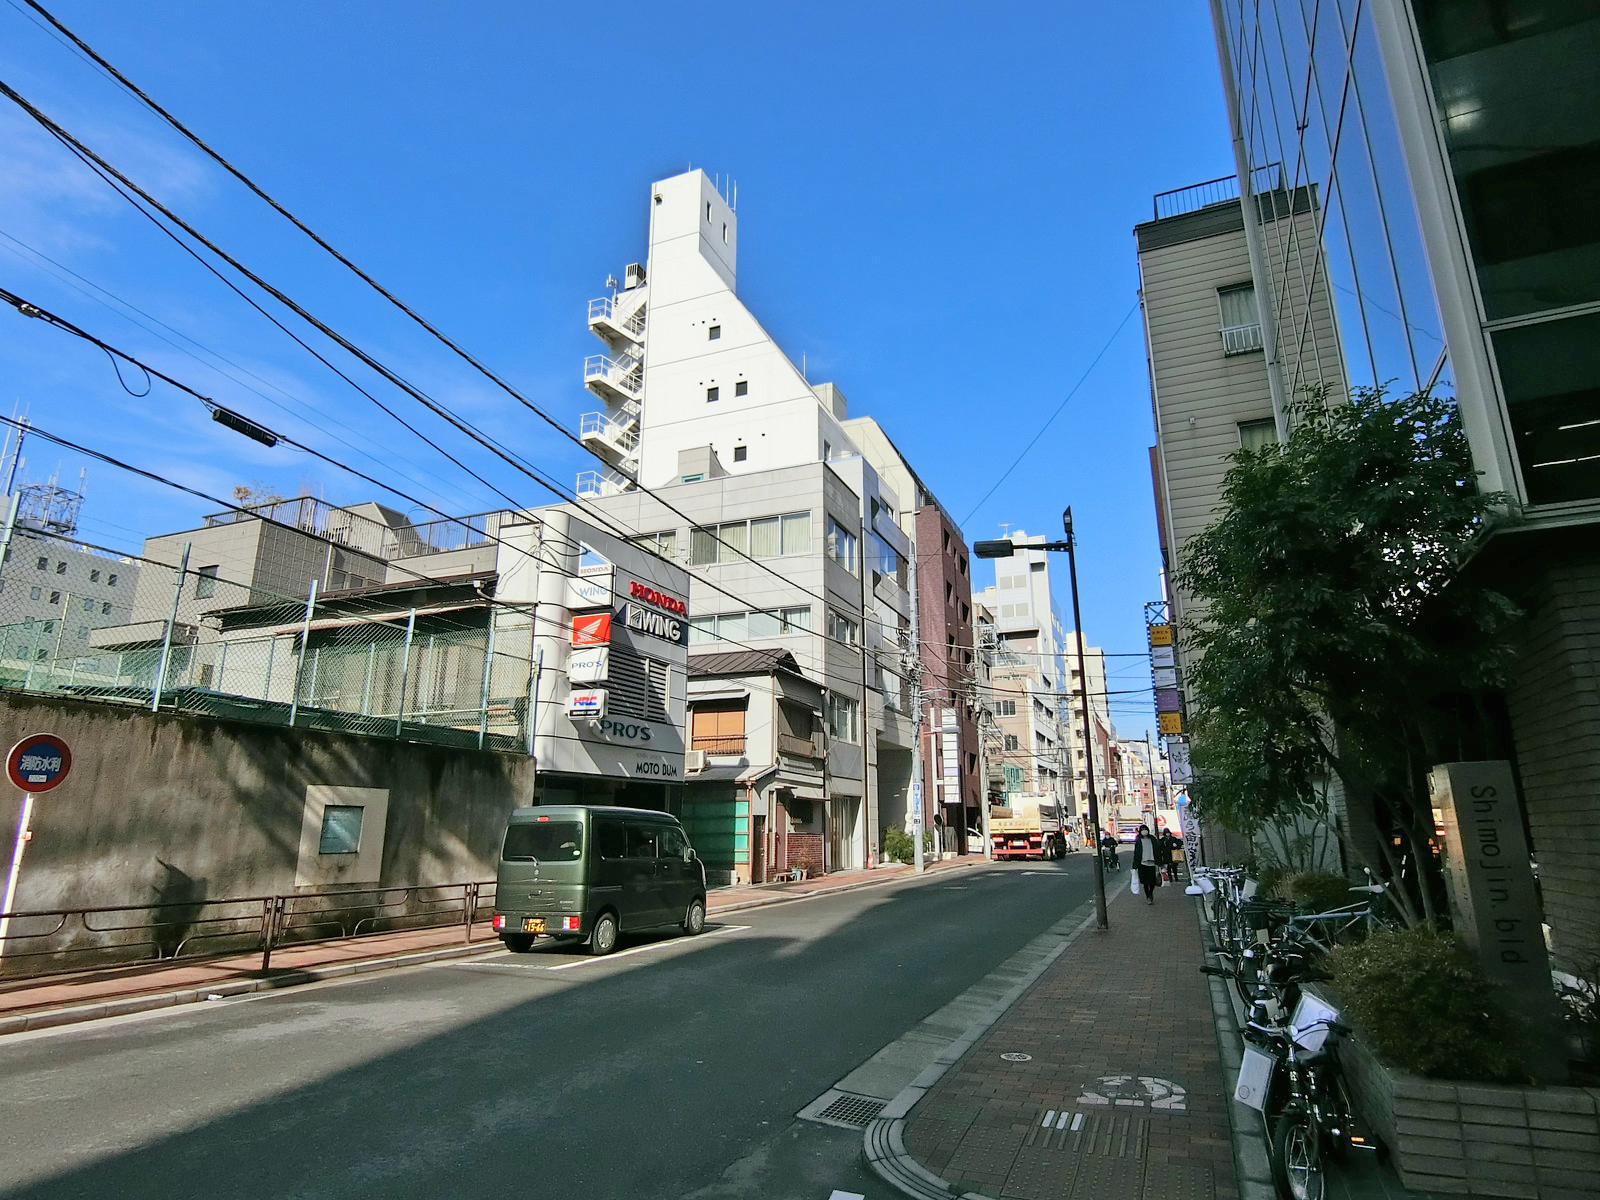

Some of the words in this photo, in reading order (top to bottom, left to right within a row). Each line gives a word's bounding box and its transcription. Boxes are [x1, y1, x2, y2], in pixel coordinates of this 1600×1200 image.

[580, 566, 609, 574] HONDA
[580, 586, 608, 597] WING
[629, 580, 688, 617] HONDA
[641, 609, 681, 641] WING
[572, 661, 602, 669] PRO'S
[573, 696, 598, 706] HRC
[600, 719, 652, 741] PRO'S
[20, 755, 62, 772] 消防水利
[635, 762, 660, 776] MOTO
[527, 923, 545, 933] 15-66
[1493, 918, 1529, 964] bld
